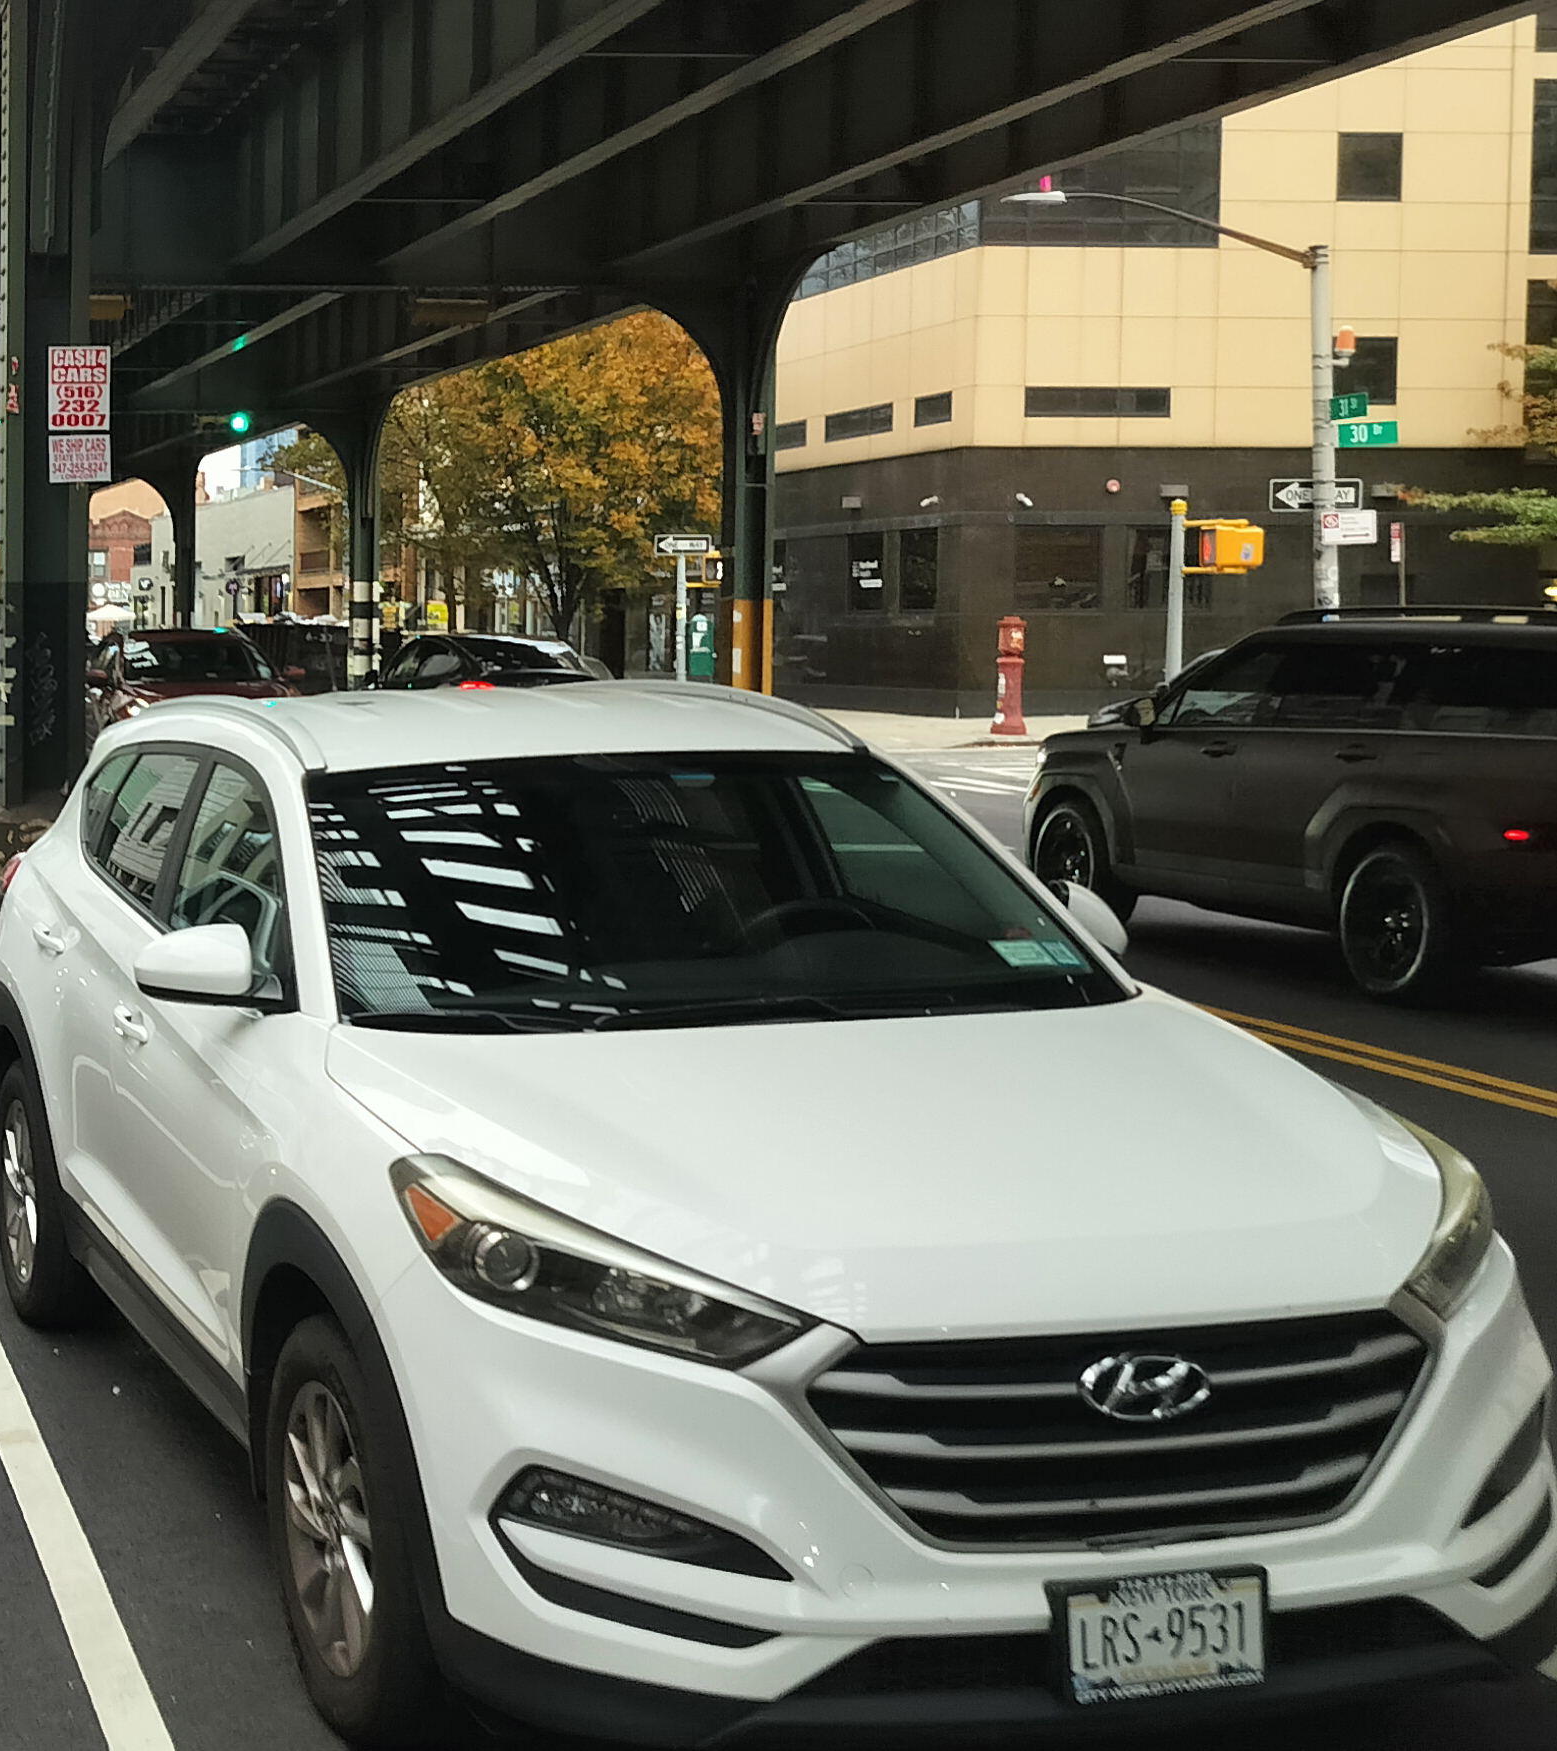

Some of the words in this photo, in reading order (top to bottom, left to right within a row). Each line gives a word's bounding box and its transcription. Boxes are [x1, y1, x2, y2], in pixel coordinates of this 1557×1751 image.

[53, 367, 106, 382] CARS
[56, 384, 104, 399] (516)
[58, 399, 100, 413] 232
[1339, 398, 1349, 417] 31
[51, 413, 106, 428] 0007
[1349, 424, 1369, 444] 30
[1373, 424, 1384, 436] Dr
[52, 438, 64, 454] WE
[65, 438, 83, 453] SHIP
[84, 437, 106, 453] CARS
[54, 453, 74, 462] STATE
[75, 453, 84, 462] TO
[85, 452, 106, 462] STATE
[1285, 489, 1312, 501] ONE
[1334, 489, 1351, 501] AY
[1079, 1611, 1142, 1670] LRS
[1167, 1601, 1247, 1659] 9531
